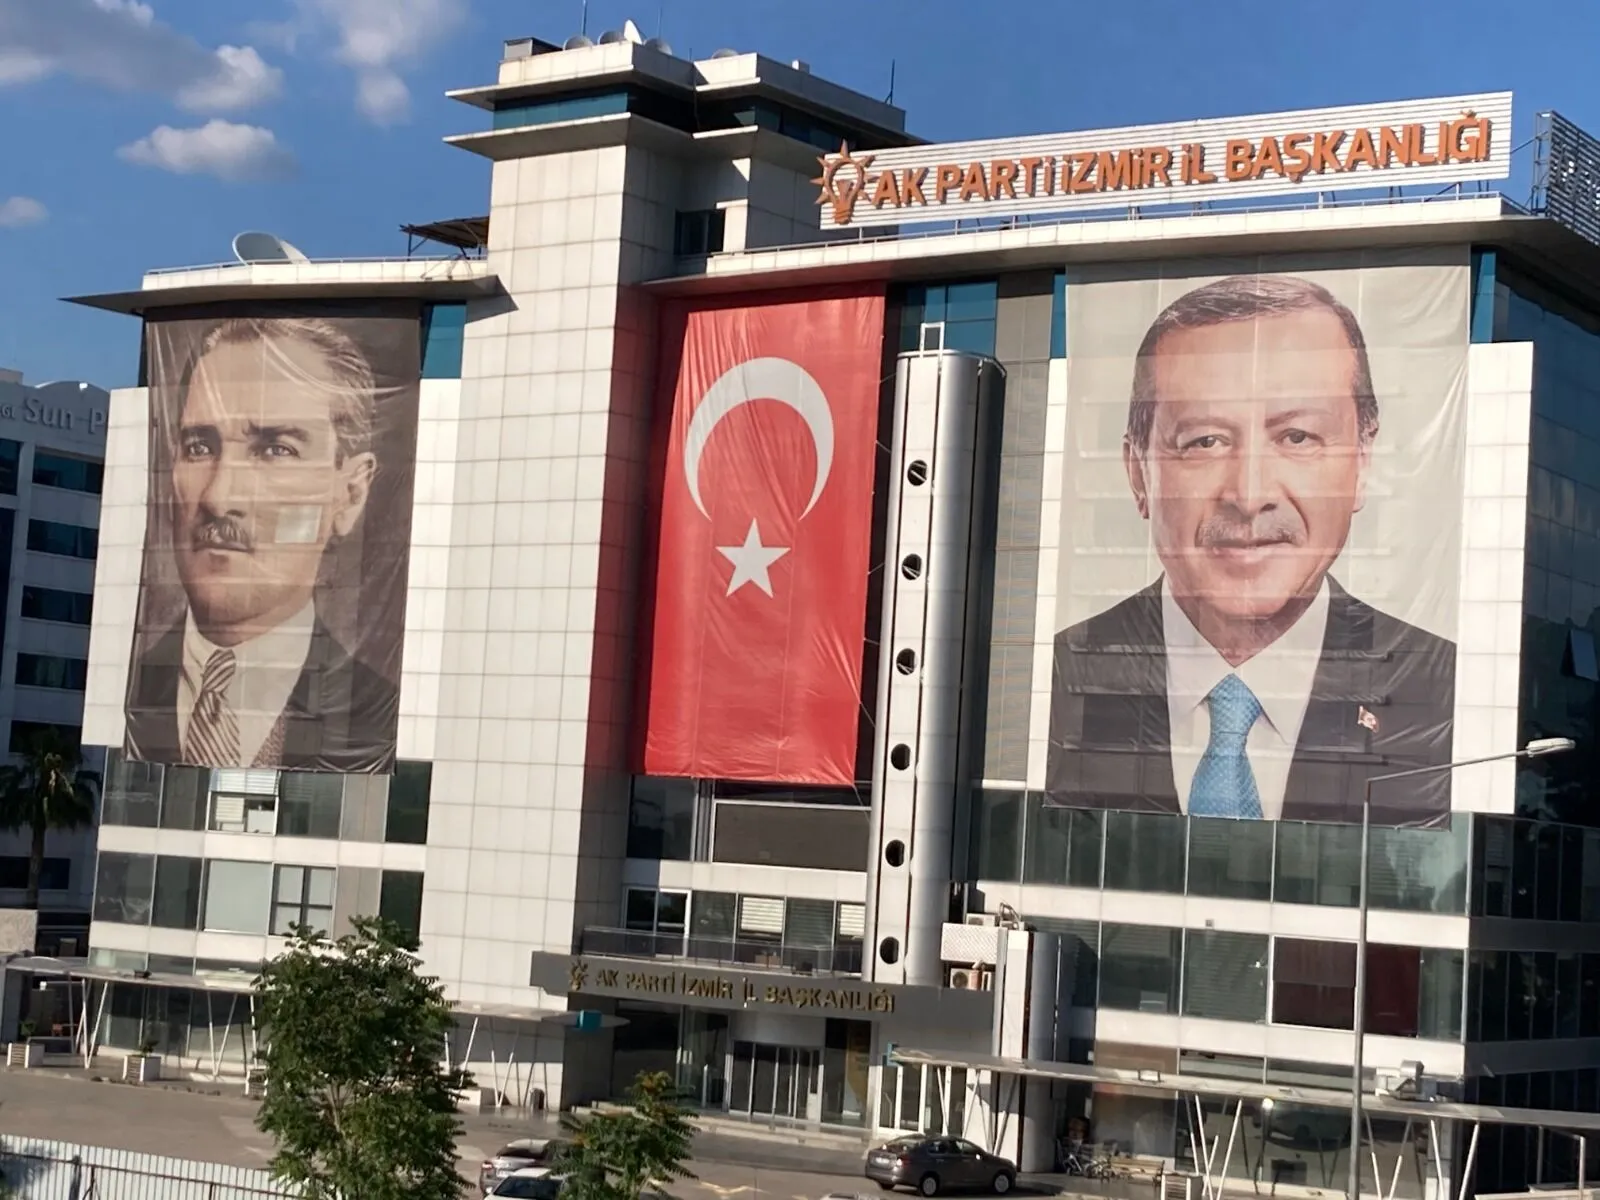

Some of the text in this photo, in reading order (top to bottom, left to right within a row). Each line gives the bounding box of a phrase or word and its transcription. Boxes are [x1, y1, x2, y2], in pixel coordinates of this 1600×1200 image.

[871, 109, 1493, 209] AK PARTİ İZMİR İL BAŞKANLIĞI
[24, 396, 73, 429] Sun
[596, 968, 620, 987] AK
[681, 972, 734, 1000] İZMİR
[764, 983, 895, 1013] BAŞKANLIĞI
